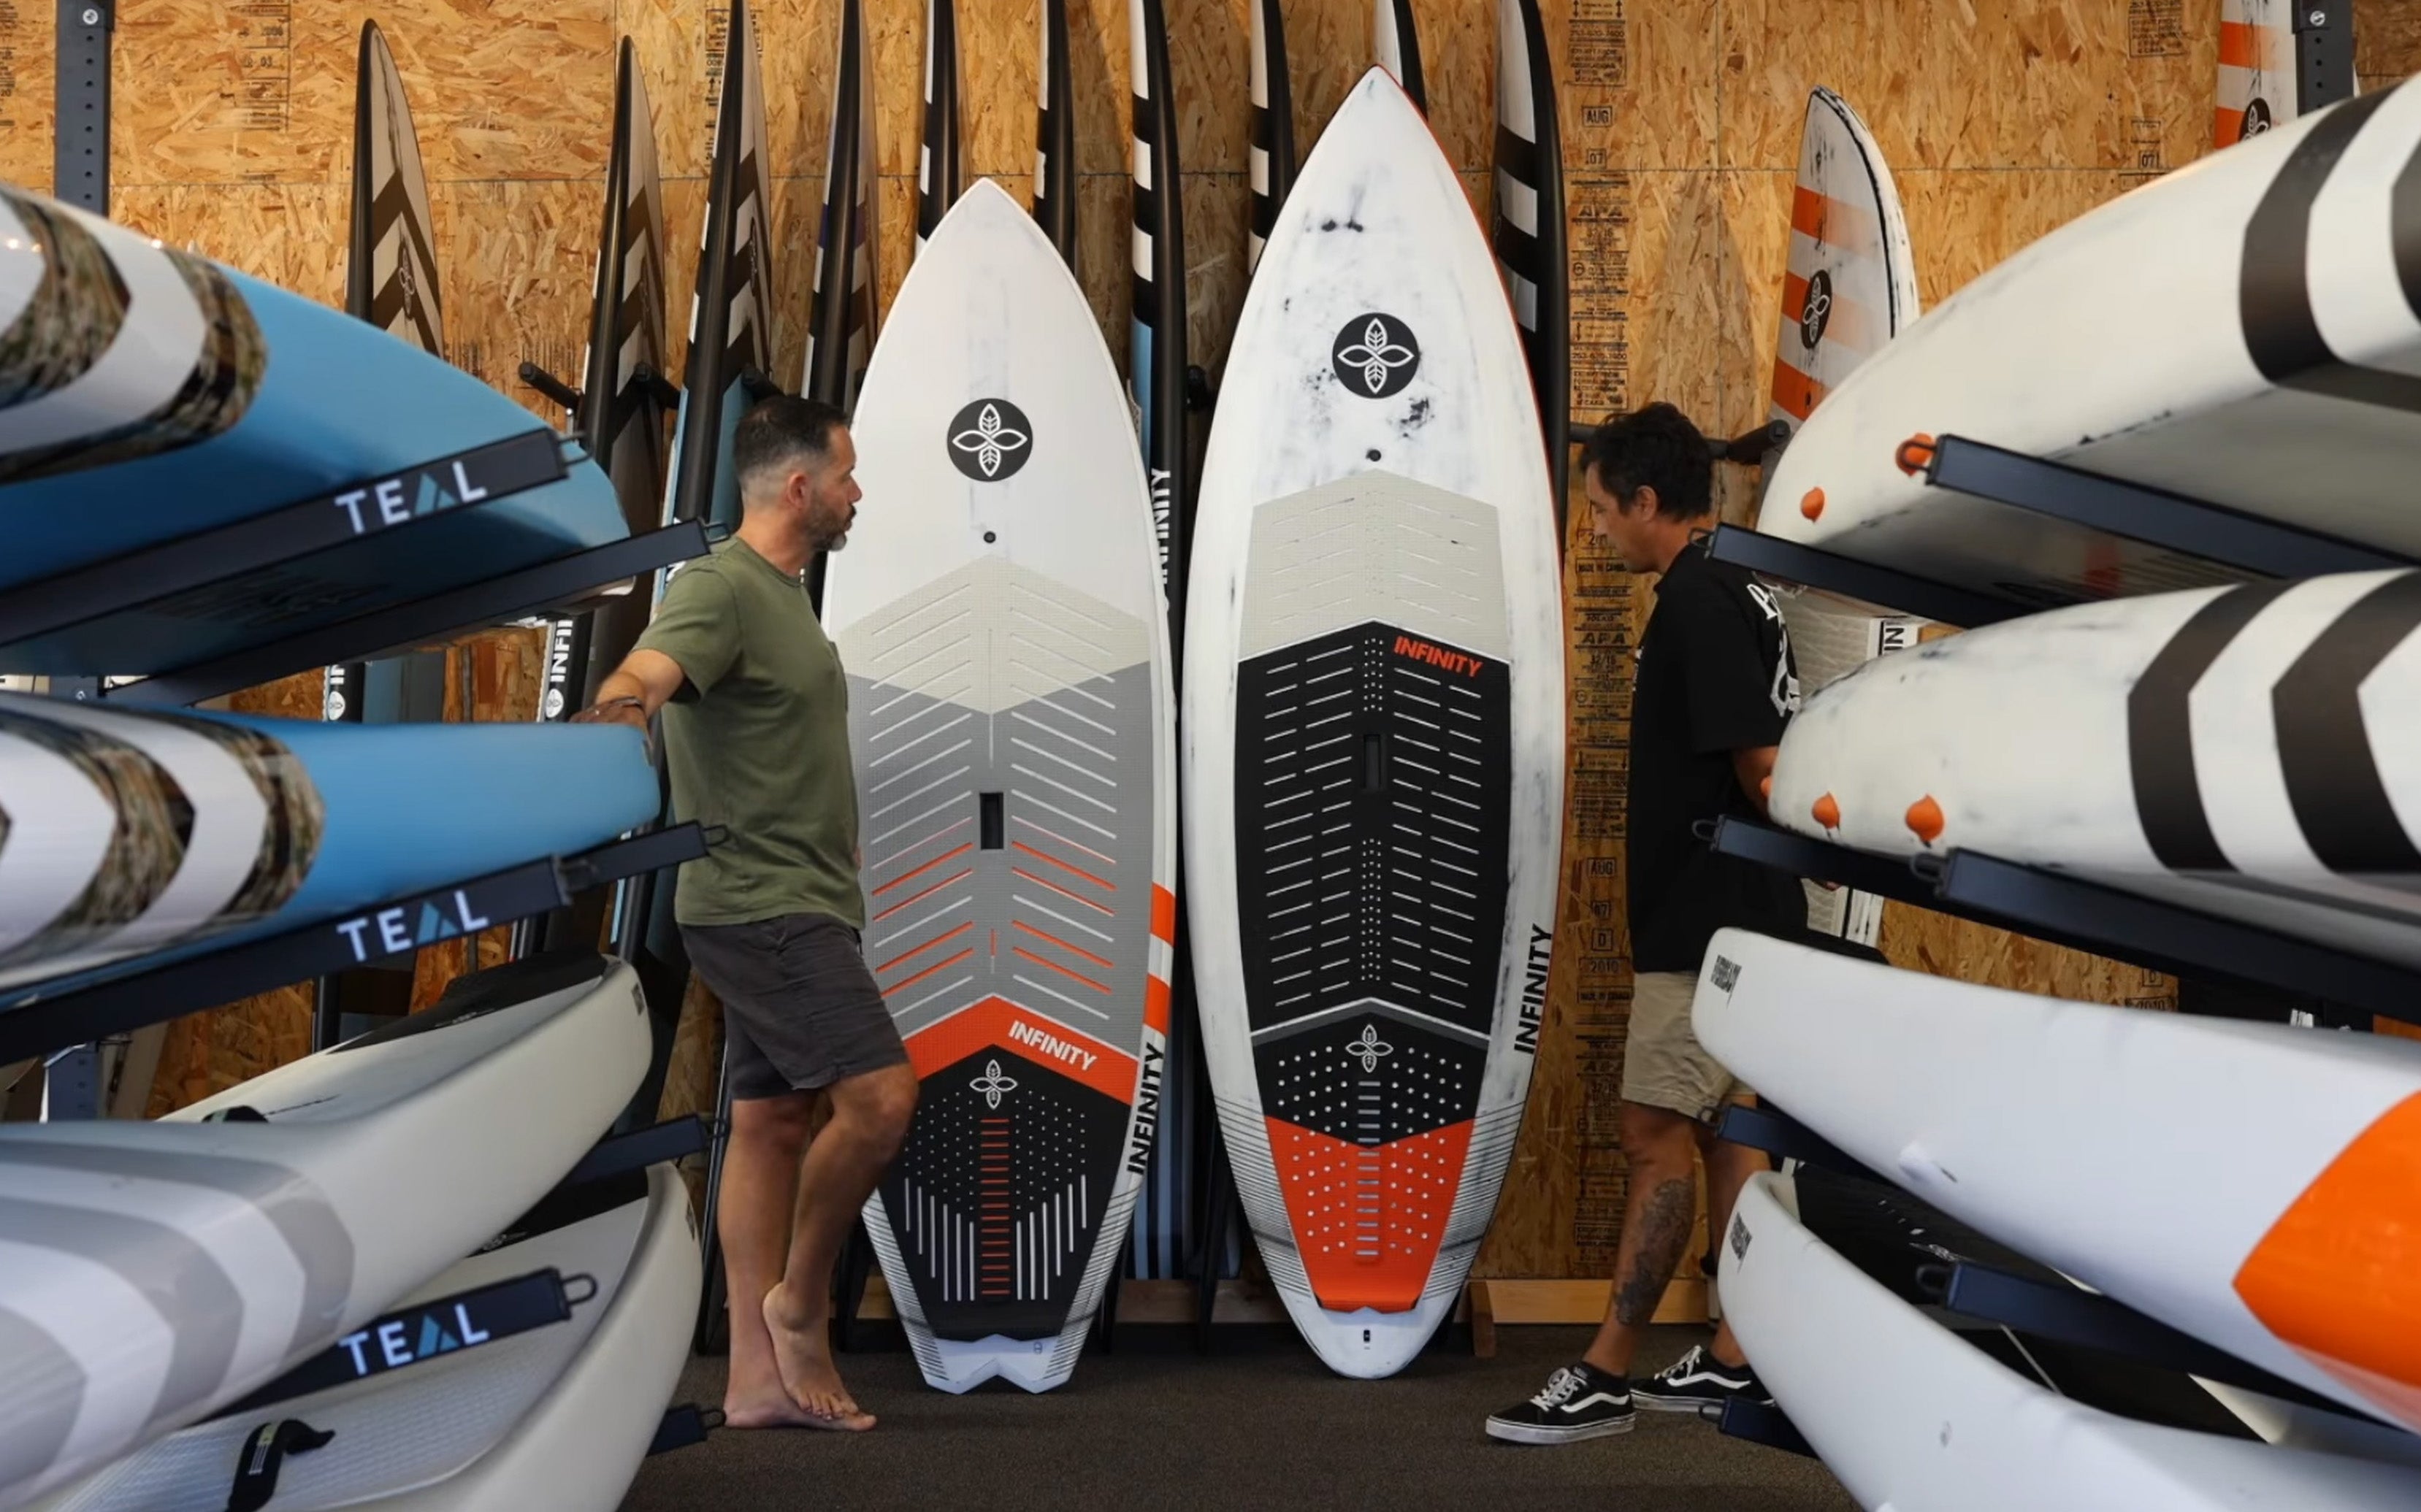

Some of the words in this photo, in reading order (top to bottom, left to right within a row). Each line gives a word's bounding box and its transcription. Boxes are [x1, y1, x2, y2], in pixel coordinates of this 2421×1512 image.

[1587, 110, 1609, 123] AUG
[334, 461, 488, 534] TEAL
[1393, 635, 1483, 678] INFINITY
[1582, 632, 1626, 644] APA
[1591, 860, 1613, 875] AUG
[336, 889, 489, 962] TEAL
[1514, 923, 1552, 1054] INFINITY
[1591, 960, 1619, 972] 2010
[1008, 1020, 1097, 1071] INFINITY
[1126, 1042, 1164, 1175] INFINITY
[337, 1303, 491, 1376] TEAL
